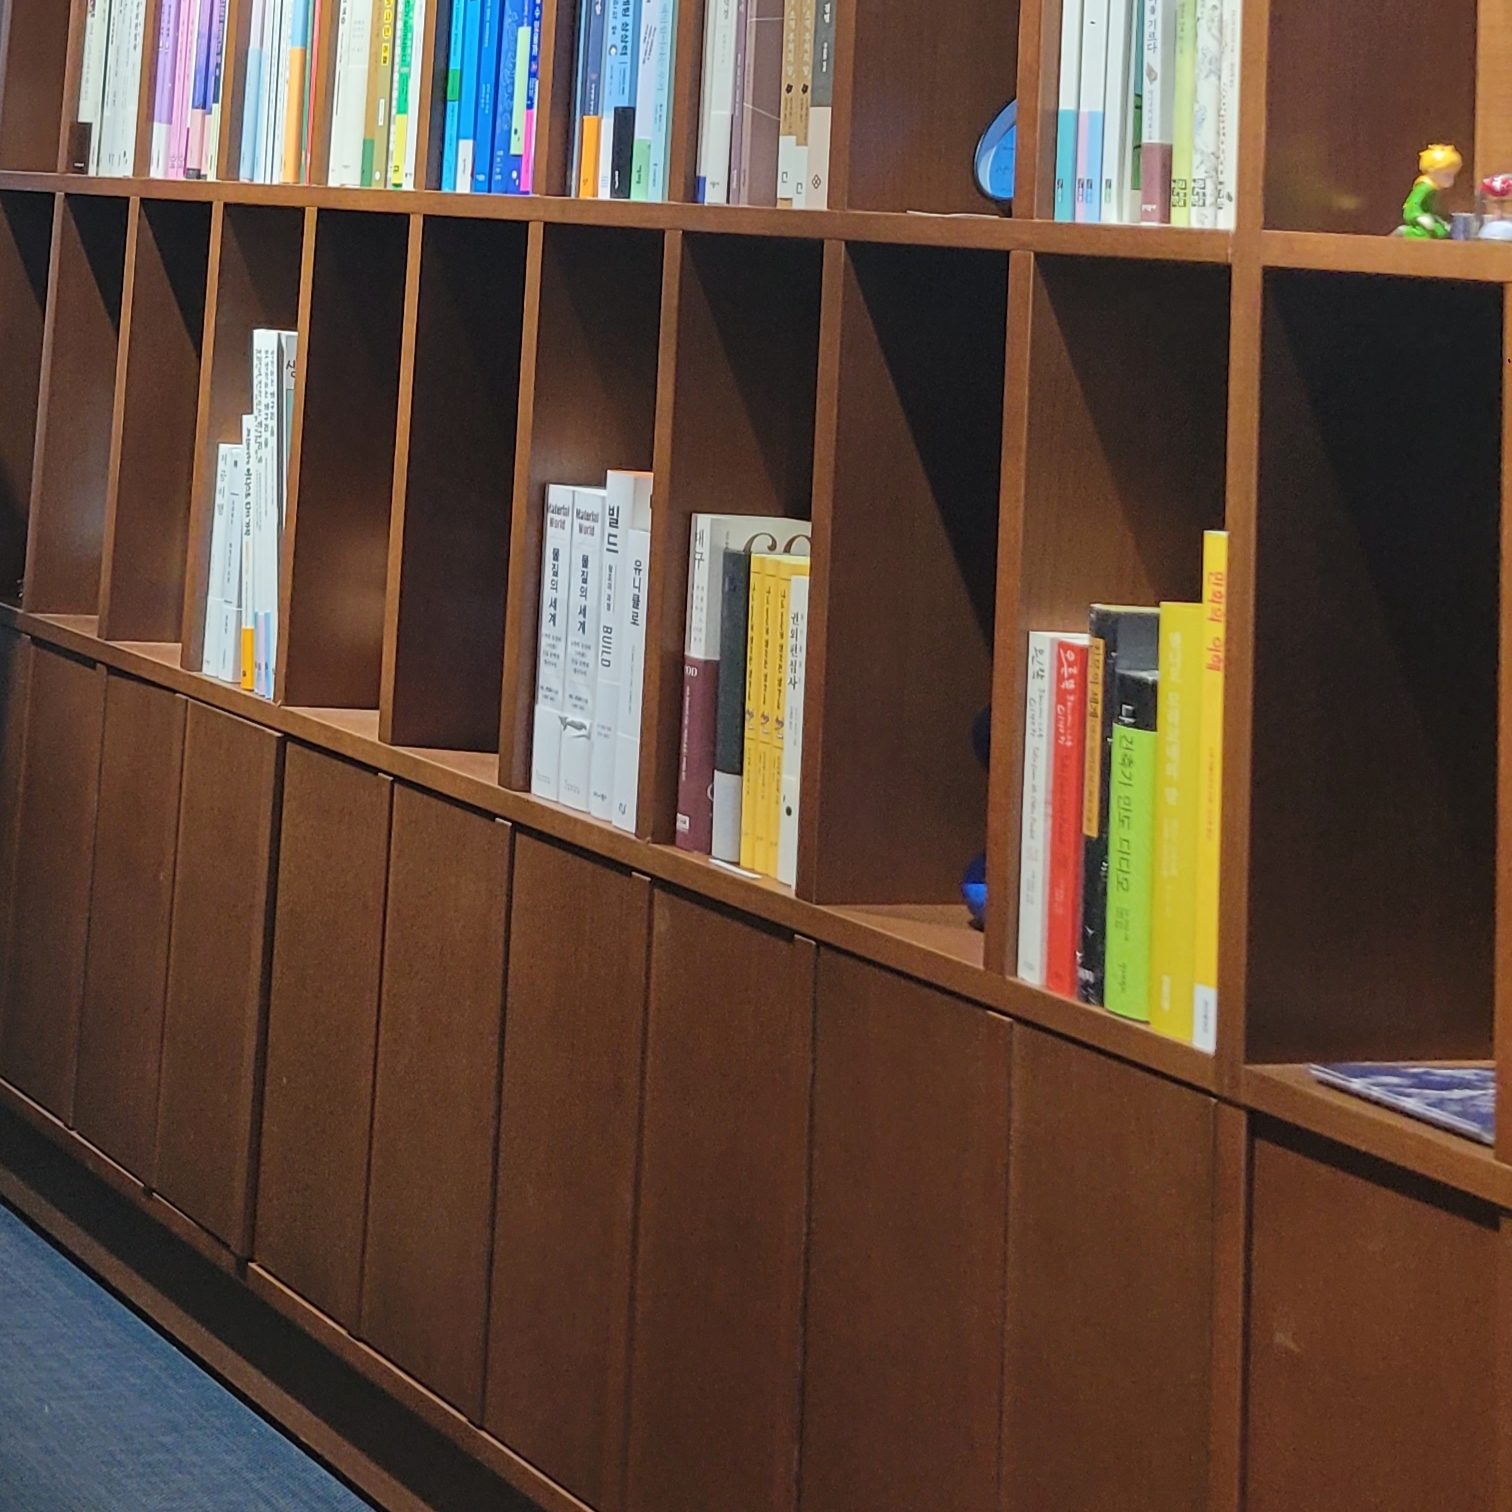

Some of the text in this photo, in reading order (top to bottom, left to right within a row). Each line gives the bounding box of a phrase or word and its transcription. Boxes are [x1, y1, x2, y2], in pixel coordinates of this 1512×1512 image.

[619, 21, 630, 57] 상상력
[1146, 18, 1158, 55] 기르다
[605, 505, 620, 554] 빌드
[548, 547, 560, 627] 물질의 세계
[577, 554, 590, 635] 물질의 세계
[630, 559, 643, 627] 유니클로
[600, 624, 614, 668] BUILD
[1206, 571, 1224, 672] 만화의 이해
[1059, 648, 1078, 688] 오른쪽
[1116, 795, 1133, 830] 안도
[1115, 838, 1131, 893] 다다오
